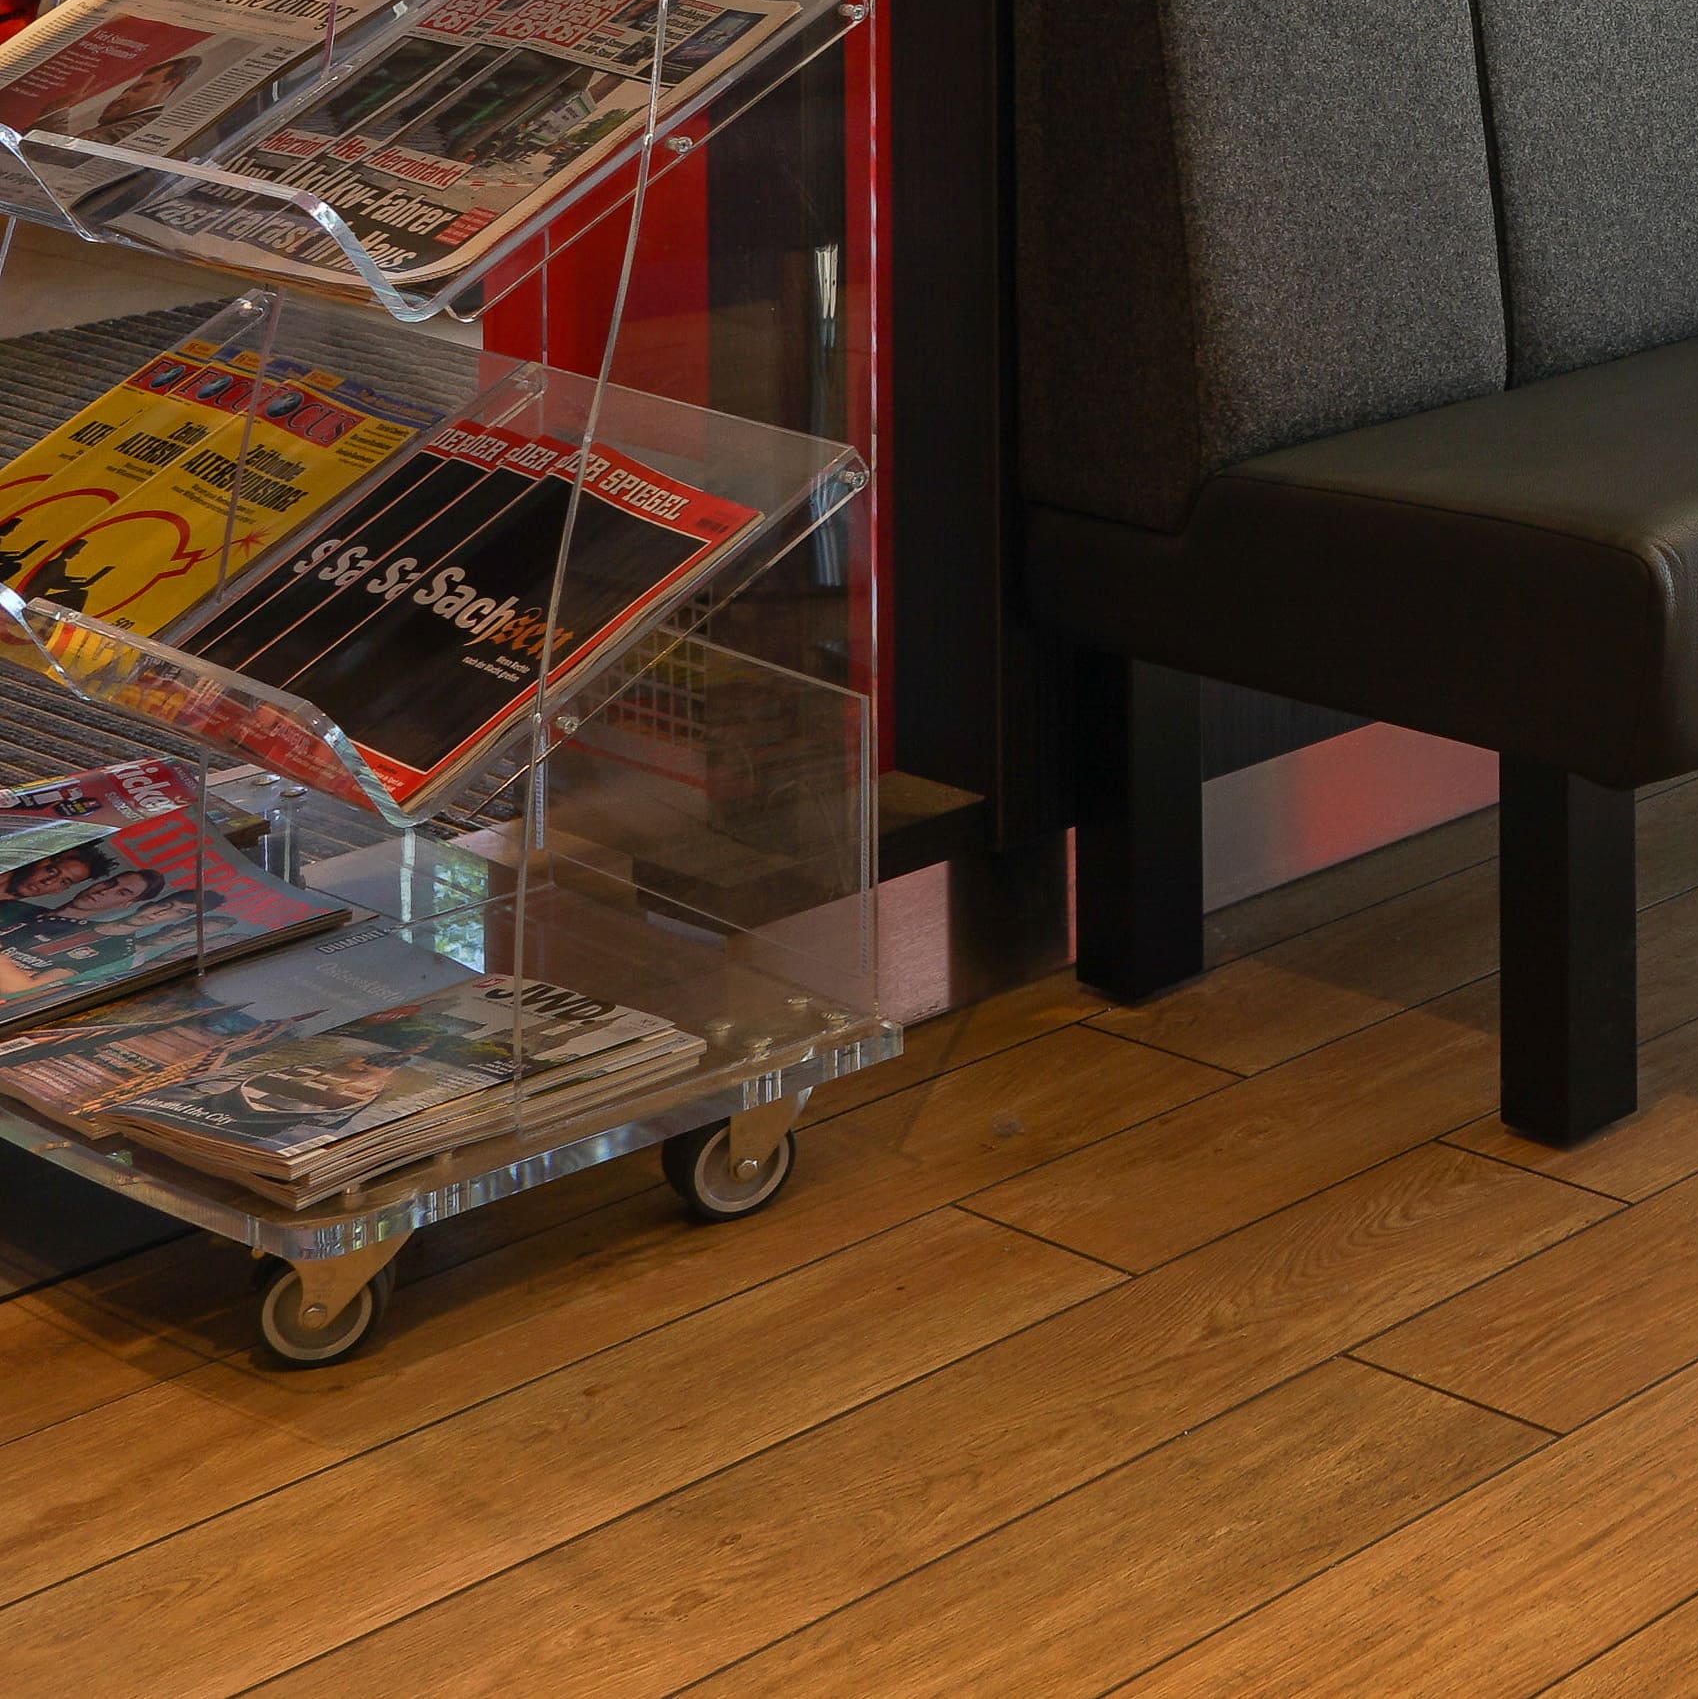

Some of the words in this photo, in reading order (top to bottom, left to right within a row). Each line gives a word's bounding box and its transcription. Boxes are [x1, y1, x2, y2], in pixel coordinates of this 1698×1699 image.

[371, 148, 464, 188] Herzinfarkt
[317, 170, 459, 236] Lkw-Fahrer
[249, 217, 326, 252] rast
[599, 469, 690, 521] SPIEGEL
[413, 566, 575, 661] Sachsen
[102, 762, 183, 816] kicker
[318, 929, 386, 955] DUMONT
